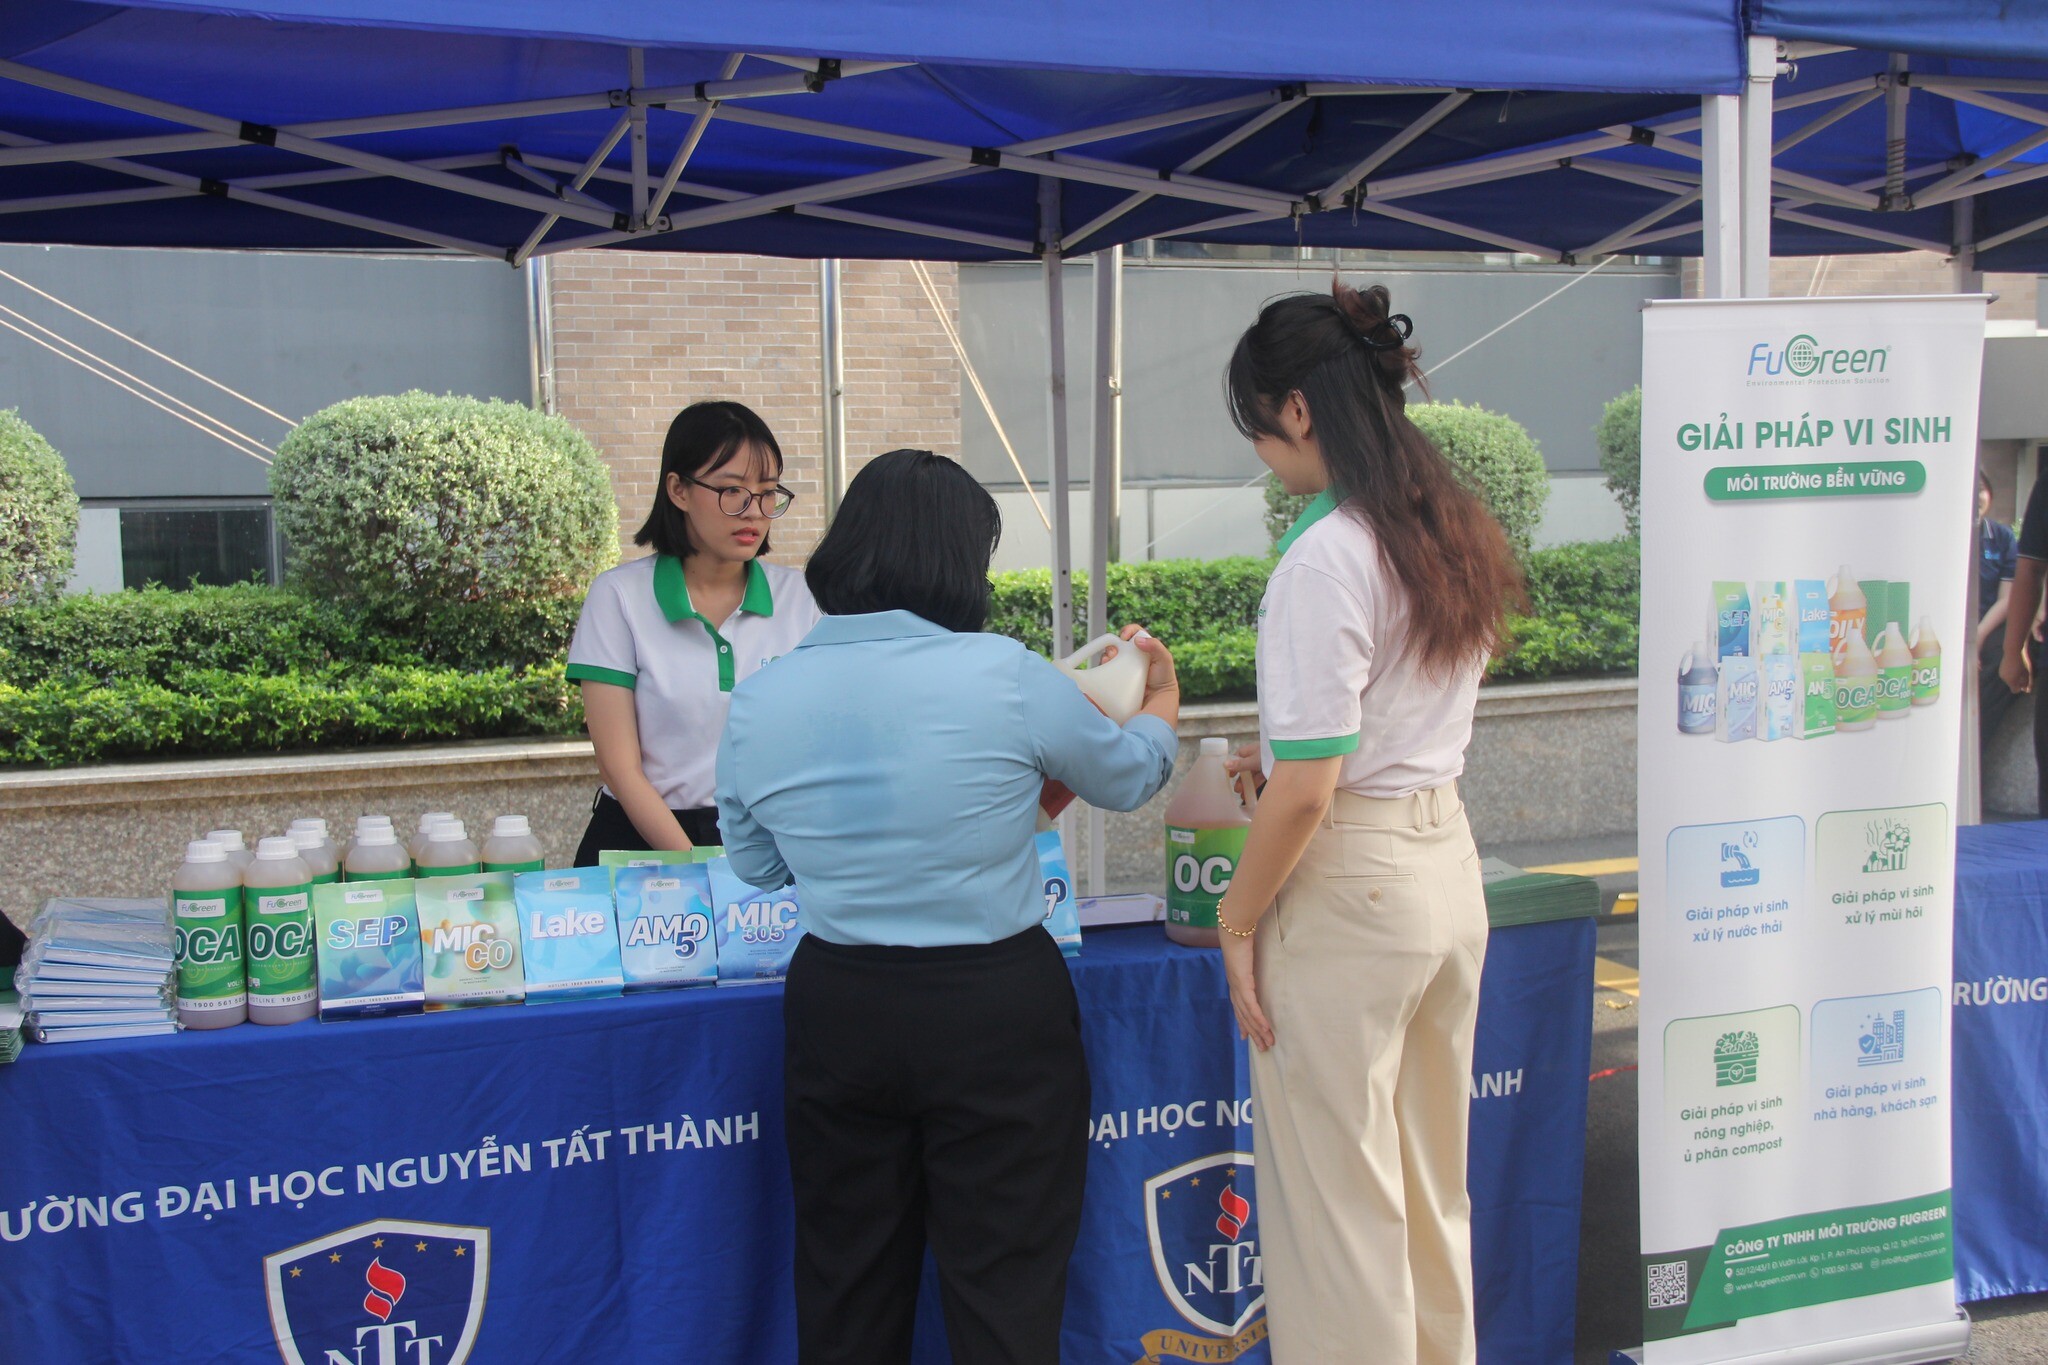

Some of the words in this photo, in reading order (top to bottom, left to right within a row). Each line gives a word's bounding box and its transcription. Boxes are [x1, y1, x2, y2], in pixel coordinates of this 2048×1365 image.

[1747, 334, 1888, 377] FuGreen
[1808, 378, 1850, 386] Protection
[1676, 412, 1743, 451] GIẢI
[1755, 412, 1834, 448] PHÁP
[1844, 418, 1873, 446] VI
[1884, 416, 1951, 445] SINH
[1726, 473, 1758, 492] MÔI
[1762, 471, 1822, 491] TRƯỜNG
[1826, 466, 1855, 488] BỀN
[1859, 468, 1906, 487] VỮNG
[1801, 609, 1828, 622] Lake
[1730, 682, 1757, 700] MIC
[1835, 685, 1876, 709] OCA
[266, 898, 302, 909] FuGreen
[1831, 890, 1858, 904] Giải
[1862, 889, 1896, 904] pháp
[1899, 887, 1910, 899] vi
[1912, 884, 1934, 897] sinh
[181, 902, 217, 913] FuGreen
[727, 900, 799, 933] MIC
[1686, 907, 1713, 921] Giải
[1717, 905, 1750, 921] pháp
[1753, 903, 1764, 914] vi
[1766, 899, 1789, 912] sinh
[1845, 911, 1862, 925] xử
[1865, 911, 1876, 925] lý
[1879, 908, 1901, 922] mùi
[1905, 906, 1923, 918] hôi
[326, 914, 408, 950] SEP
[530, 906, 606, 940] Lake
[741, 923, 786, 944] 305
[1692, 927, 1710, 943] xử
[1713, 927, 1724, 942] lý
[1727, 924, 1757, 938] nước
[1761, 919, 1783, 934] thải
[433, 923, 494, 954] MIC
[674, 929, 697, 959] 5
[464, 939, 513, 971] CO
[281, 995, 301, 1003] 1900
[1825, 1085, 1851, 1099] Giải
[1854, 1082, 1888, 1099] pháp
[1891, 1081, 1902, 1092] vi
[1904, 1076, 1926, 1090] sinh
[1136, 1100, 1206, 1138] HỌC
[1680, 1106, 1707, 1121] Giải
[1711, 1102, 1743, 1120] pháp
[1747, 1100, 1758, 1112] vi
[1760, 1096, 1783, 1110] sinh
[1813, 1105, 1837, 1121] nhà
[1841, 1102, 1877, 1118] hàng,
[1880, 1096, 1917, 1114] khách
[1919, 1094, 1938, 1109] sạn
[1694, 1125, 1726, 1141] nông
[1729, 1119, 1774, 1137] nghiệp,
[1684, 1147, 1692, 1162] ủ
[1695, 1145, 1728, 1163] phân
[1732, 1137, 1783, 1158] compost
[155, 1178, 236, 1221] ĐẠI
[250, 1165, 345, 1210] HỌC
[356, 1134, 532, 1194] NGUYỄN
[541, 1124, 612, 1169] TẤT
[620, 1111, 760, 1155] THÀNH
[1724, 1239, 1764, 1256] CÔNG
[1766, 1235, 1780, 1249] TY
[1782, 1229, 1815, 1246] TNHH
[1818, 1222, 1843, 1240] MÔI
[1846, 1217, 1897, 1235] TRƯỜNG
[1899, 1206, 1947, 1227] FUGREEN
